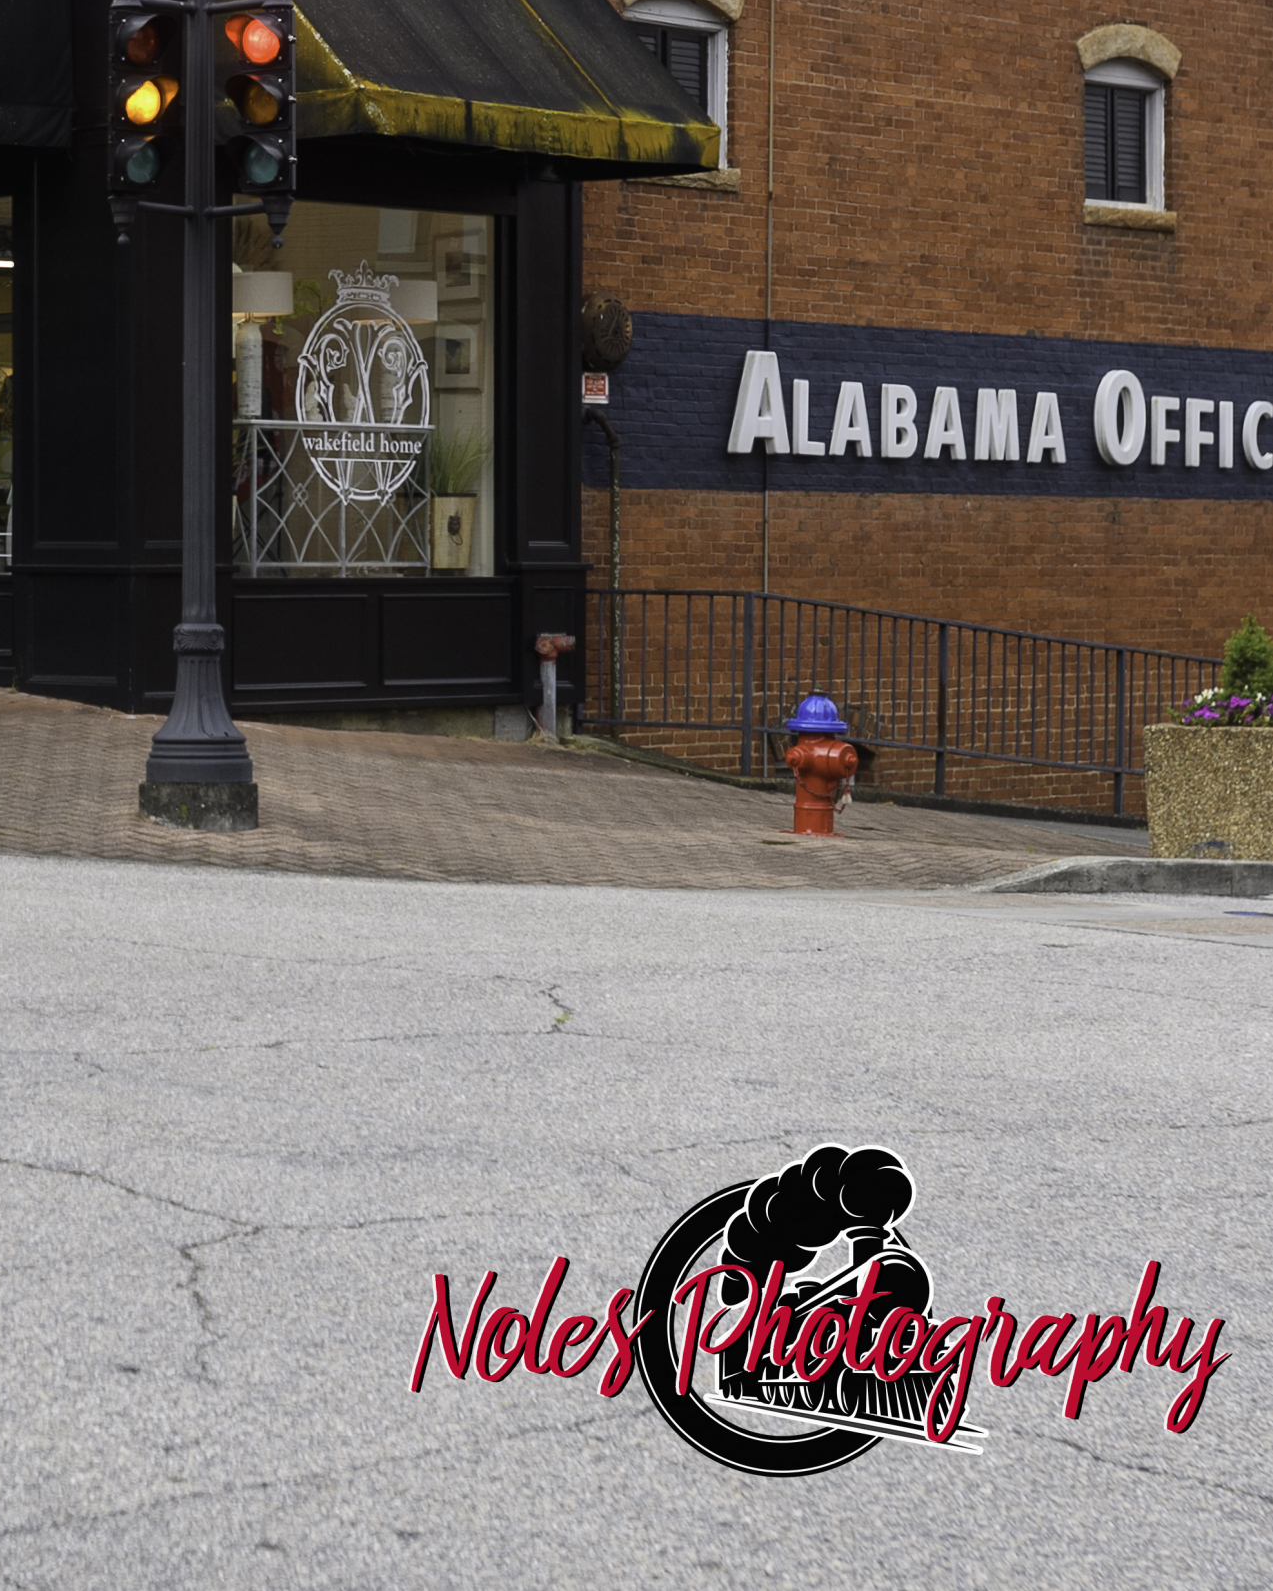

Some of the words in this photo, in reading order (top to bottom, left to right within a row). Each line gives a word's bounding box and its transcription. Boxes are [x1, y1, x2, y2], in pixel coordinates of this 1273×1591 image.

[727, 350, 1067, 465] ALABAMA
[303, 431, 375, 452] wakefield
[380, 432, 422, 454] home
